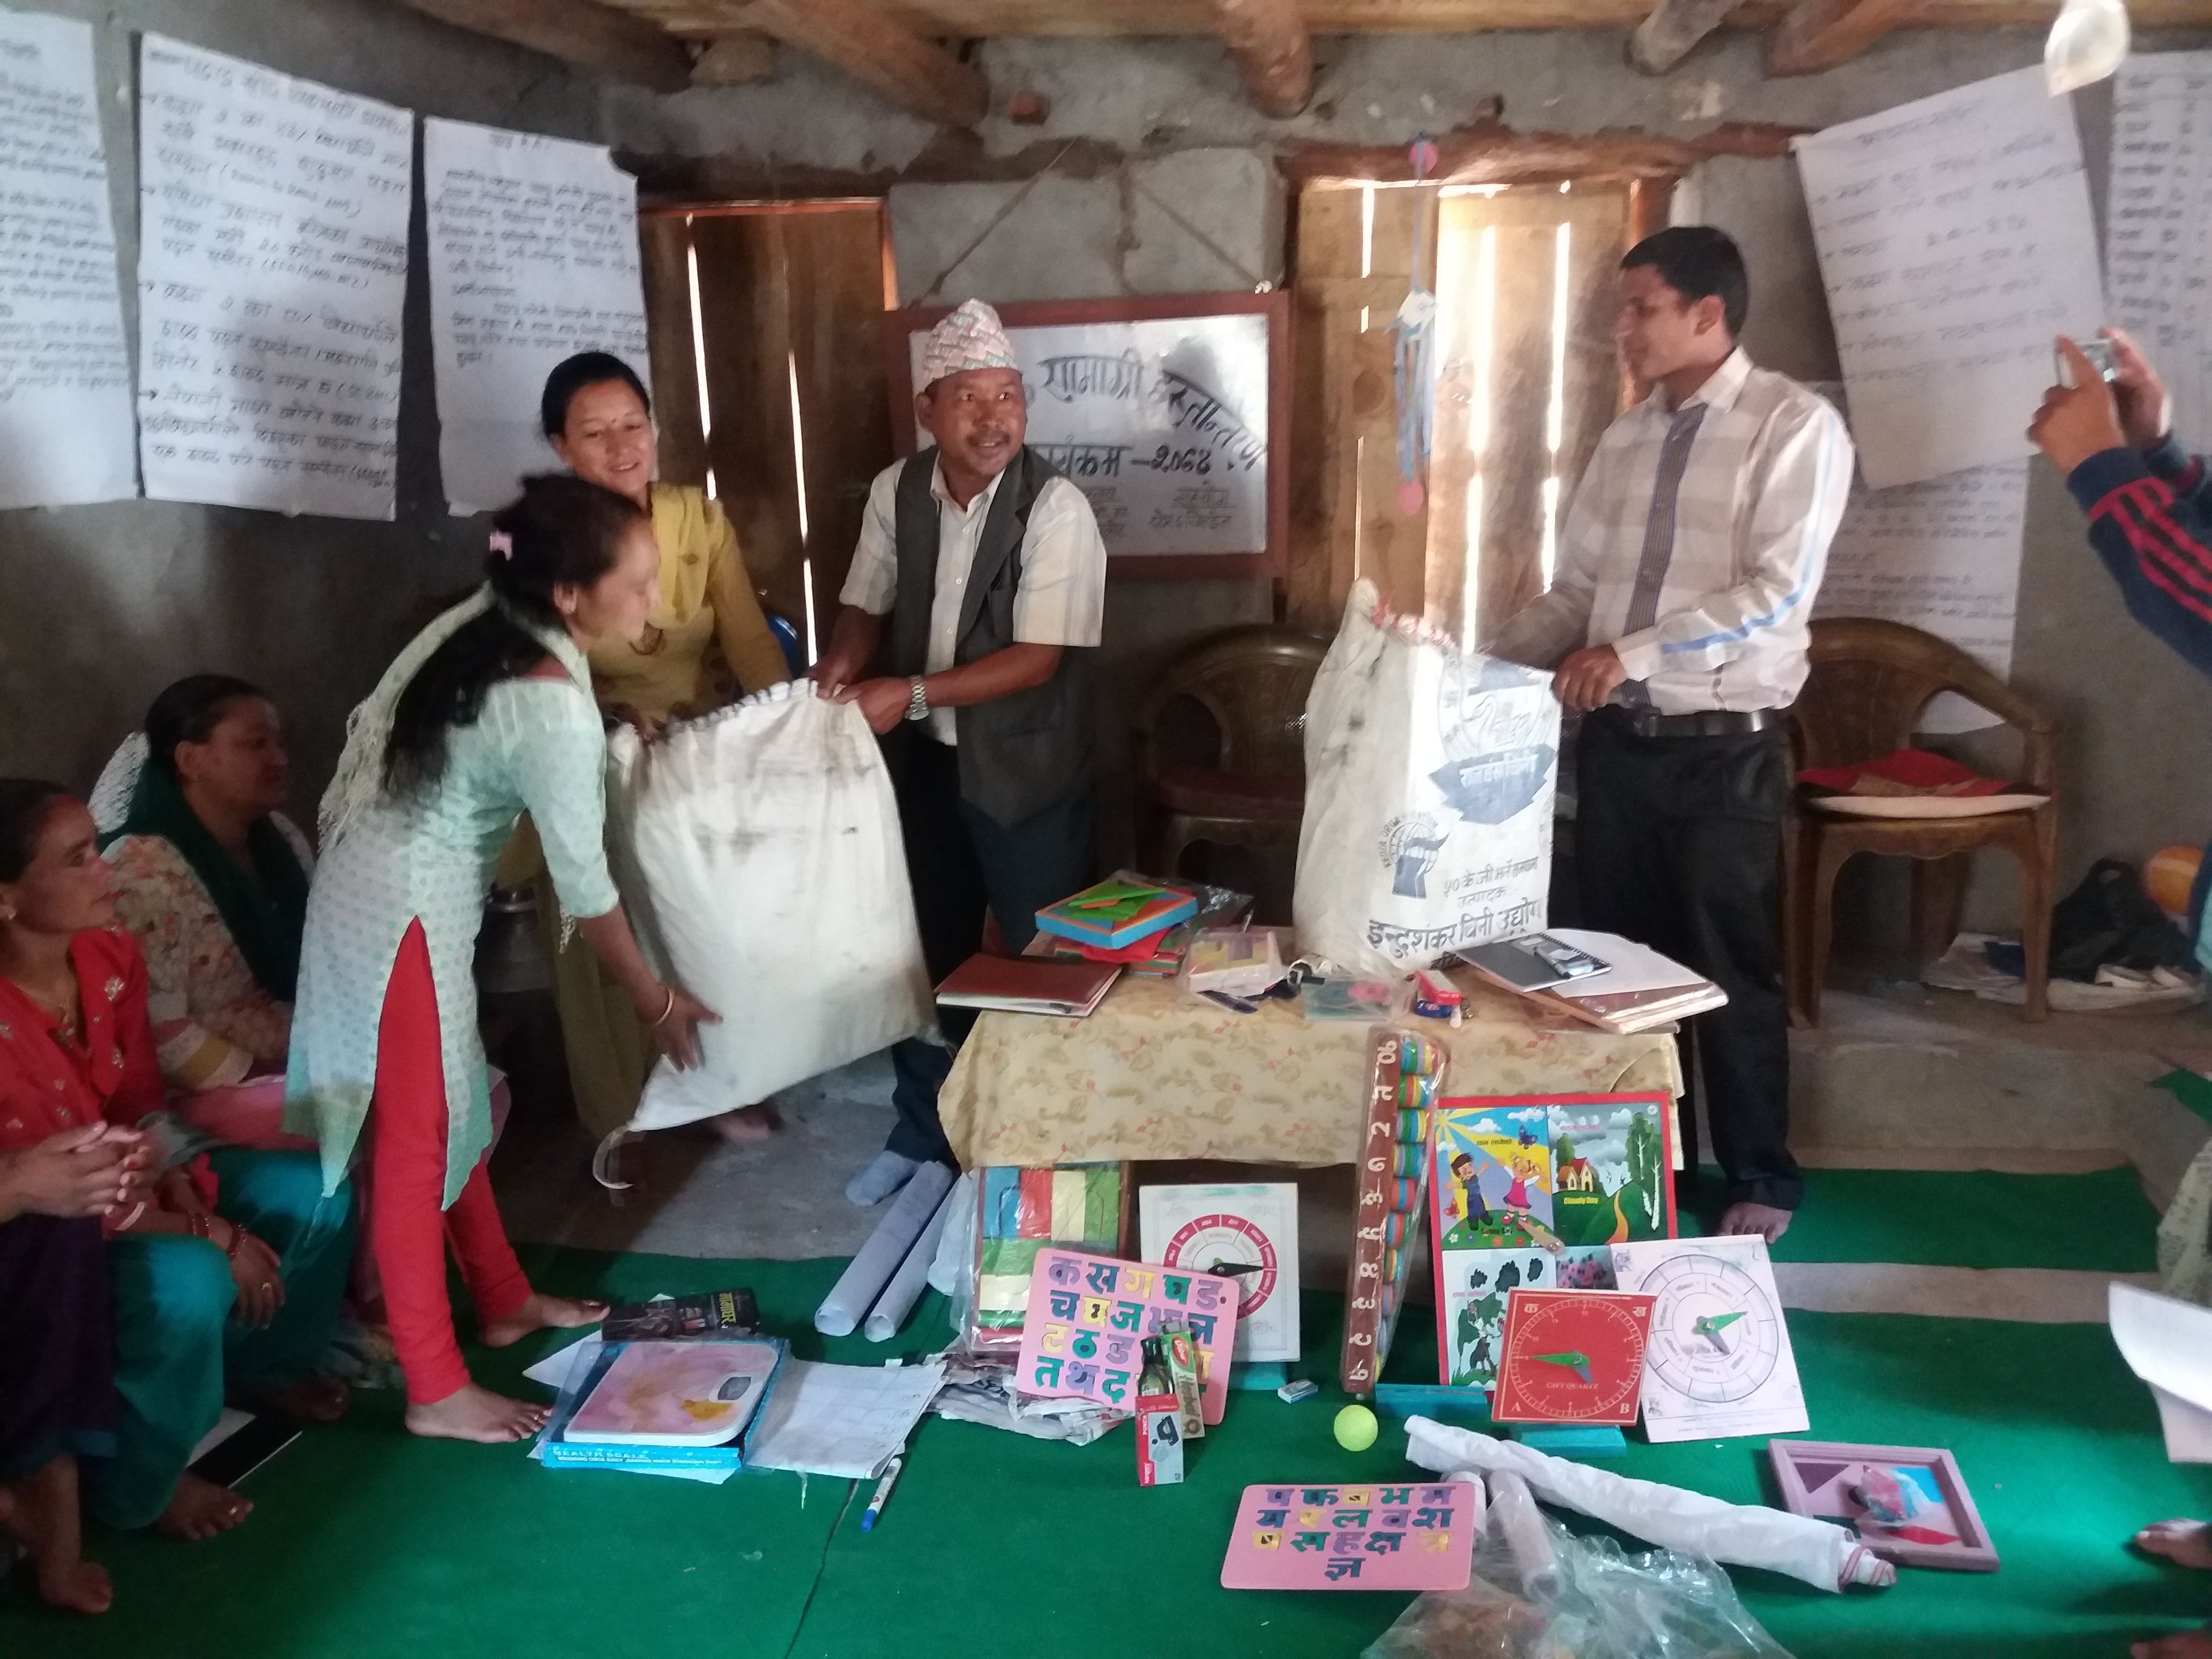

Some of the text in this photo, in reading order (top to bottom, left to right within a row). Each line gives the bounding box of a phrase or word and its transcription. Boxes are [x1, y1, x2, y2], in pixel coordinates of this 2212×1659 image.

[1049, 1257, 1081, 1286] क
[1086, 1261, 1120, 1294] ख
[1125, 1268, 1155, 1299] ग
[1050, 1289, 1080, 1321] च
[1110, 1300, 1145, 1333] ज
[1042, 1322, 1135, 1364] ट ठ ड
[1174, 1340, 1186, 1362] Dabur
[1035, 1355, 1131, 1403] त थ द
[1511, 1402, 1630, 1414] A B
[1266, 1489, 1295, 1506] प
[1301, 1488, 1339, 1506] फ
[1379, 1487, 1414, 1505] भ
[1419, 1485, 1456, 1505] म
[1256, 1507, 1455, 1529] य र ल व श
[1290, 1531, 1331, 1552] स
[1333, 1531, 1366, 1554] ह
